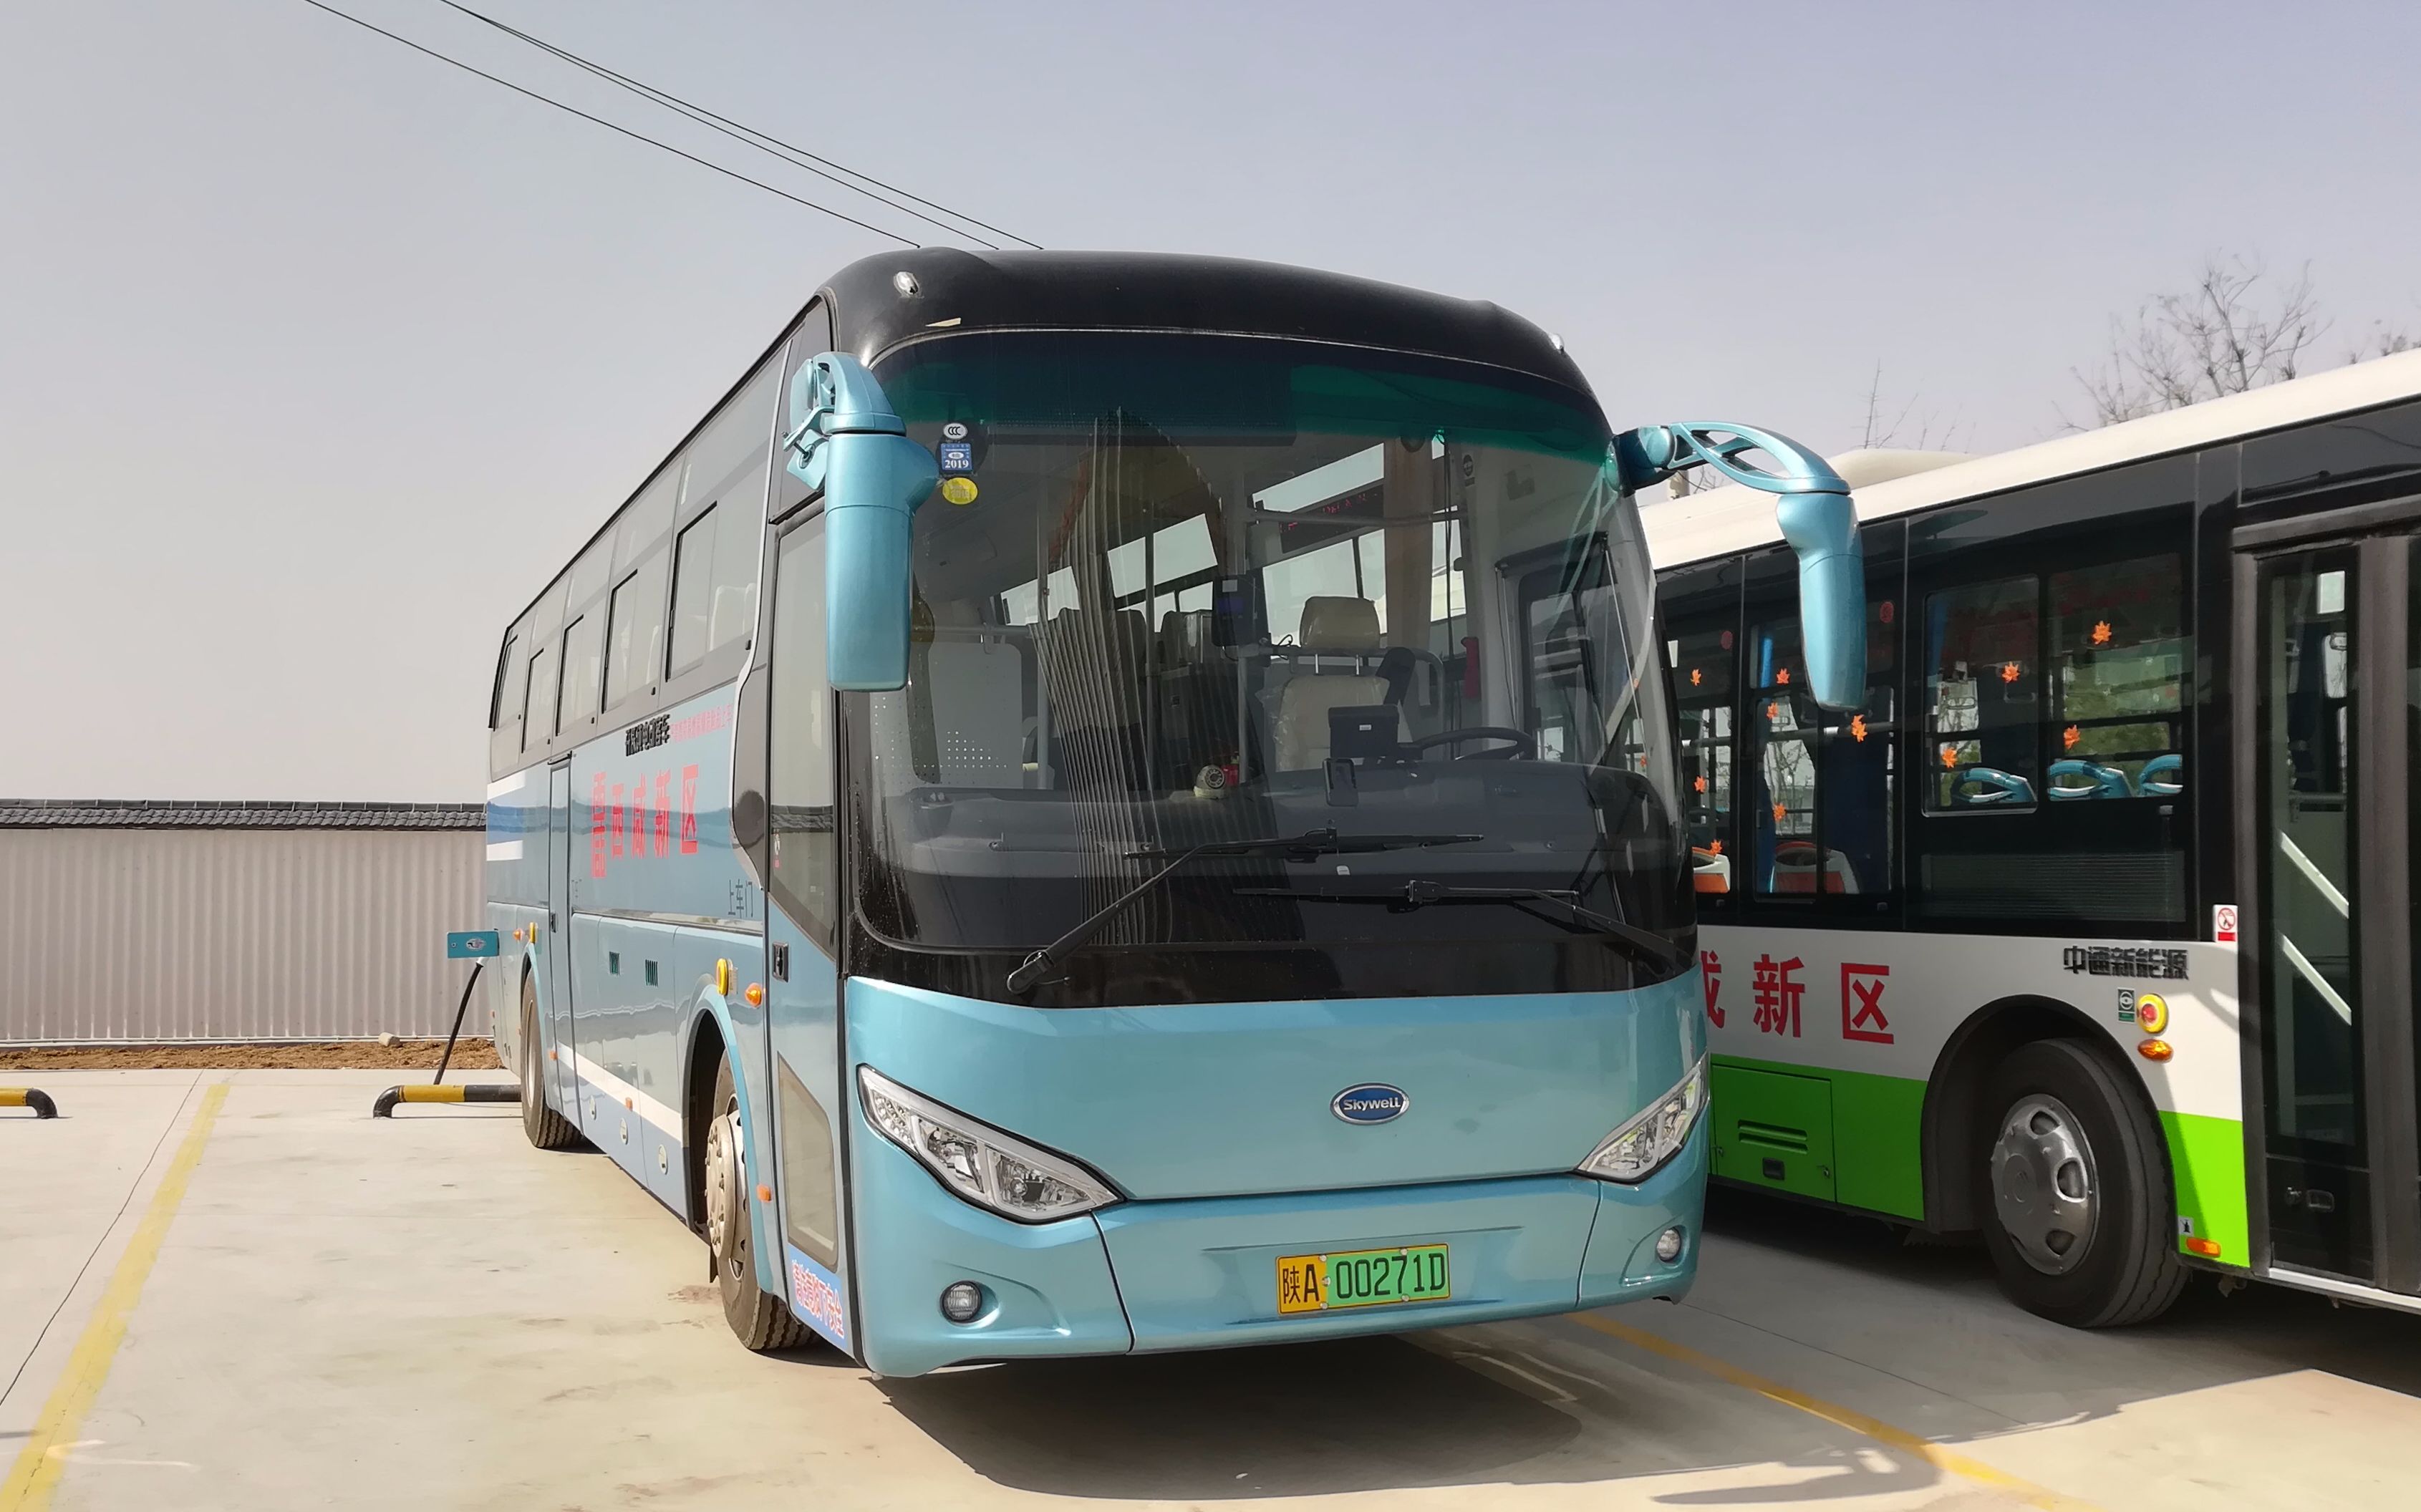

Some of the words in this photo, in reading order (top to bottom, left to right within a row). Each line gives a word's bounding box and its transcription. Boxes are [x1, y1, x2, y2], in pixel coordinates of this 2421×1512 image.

[944, 459, 970, 469] 2019
[728, 878, 753, 919] 上车门
[2063, 945, 2190, 981] 中通新能源
[1343, 1097, 1401, 1111] Skywell
